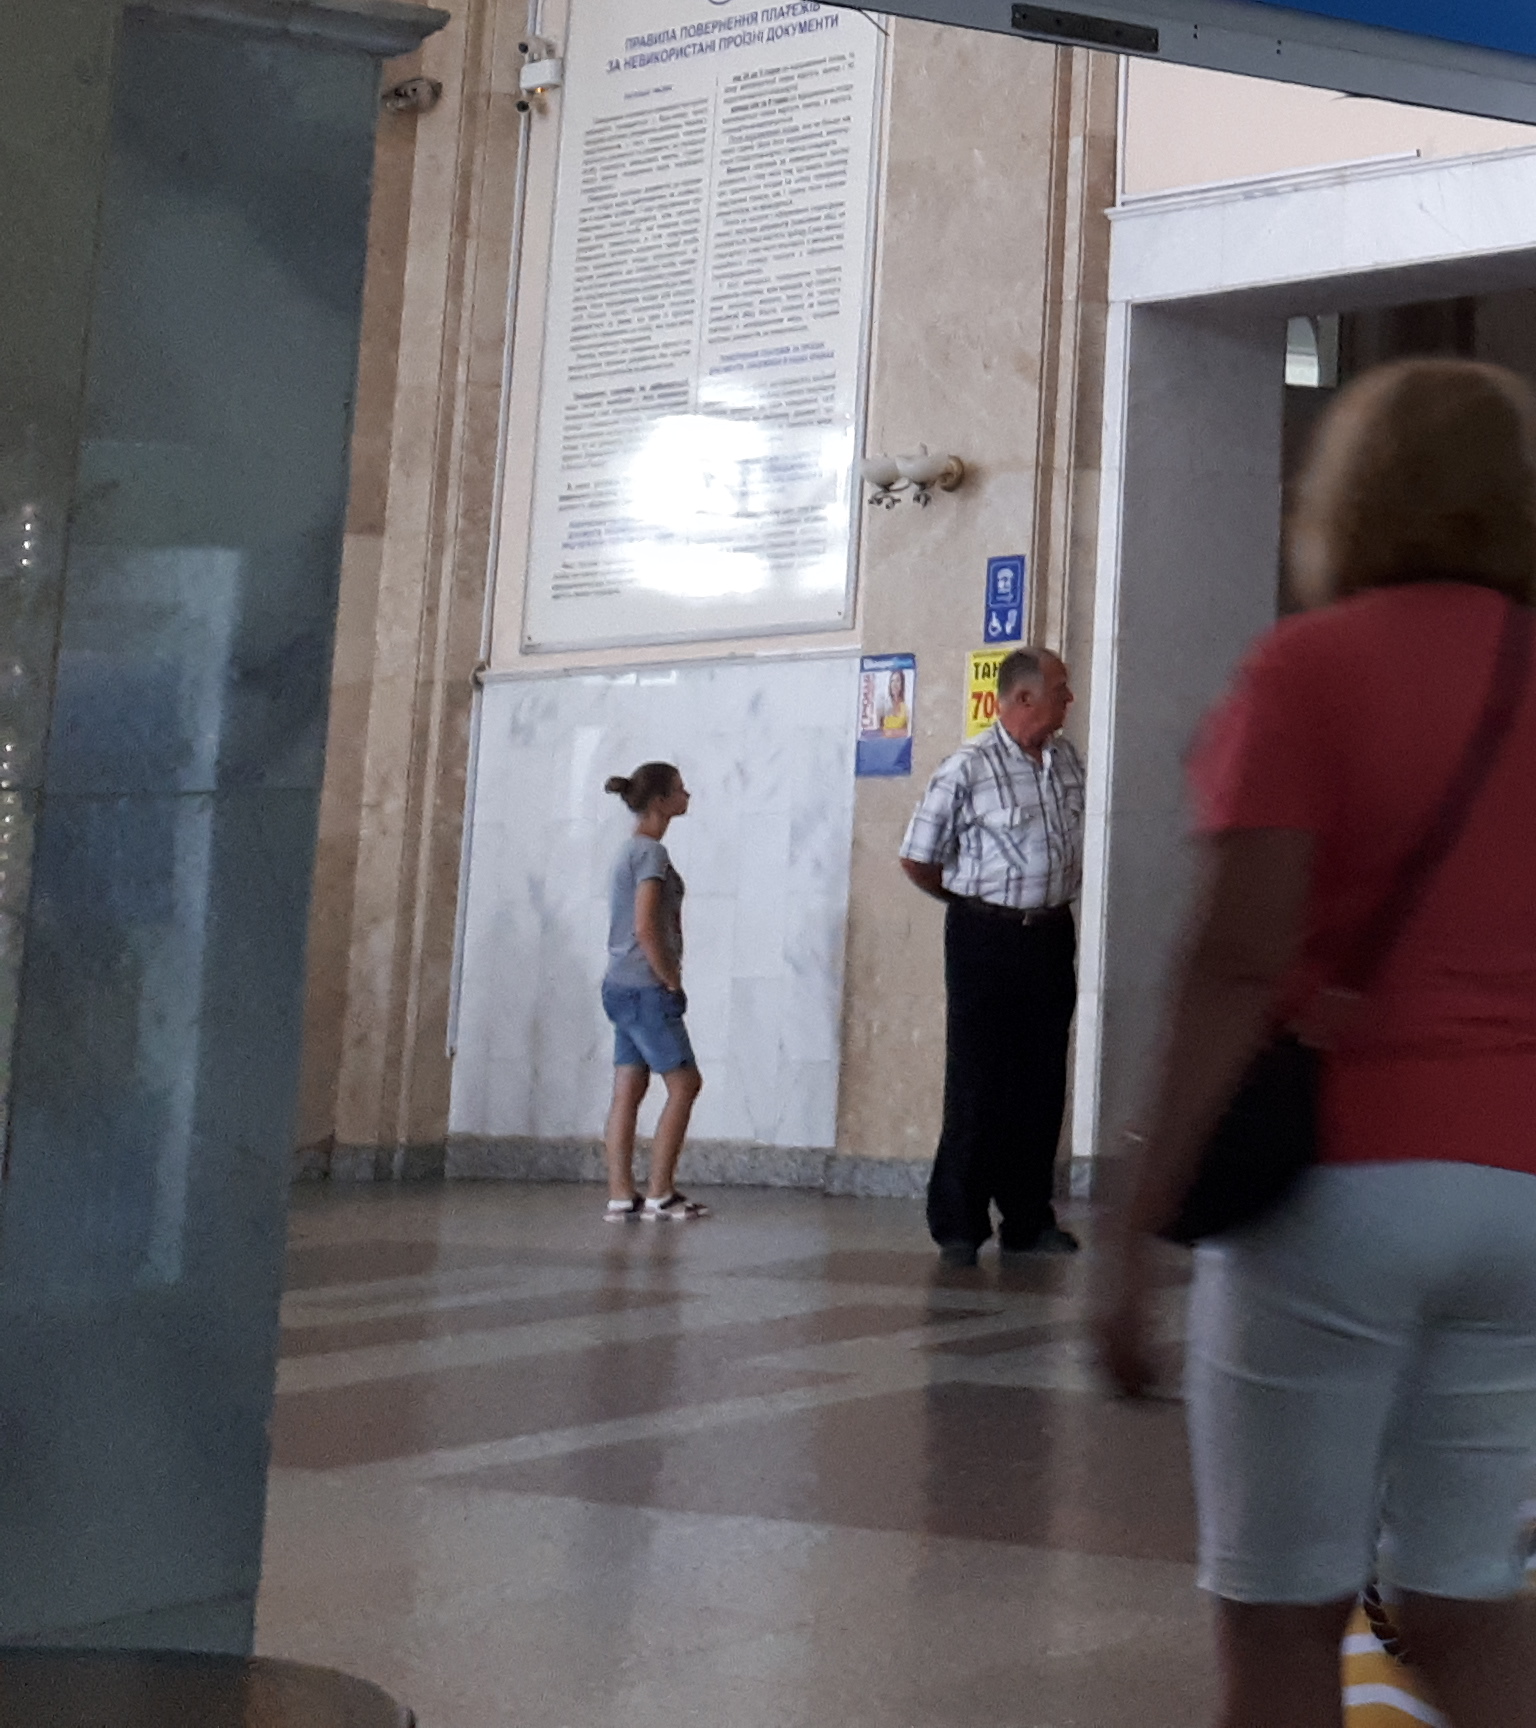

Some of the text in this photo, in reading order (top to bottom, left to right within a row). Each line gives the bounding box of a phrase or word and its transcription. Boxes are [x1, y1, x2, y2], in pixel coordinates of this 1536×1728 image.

[608, 13, 839, 73] ЗА НЕВИКОРИСТАНІ ПРОЇЗНІ ДОКУМЕНТИ
[625, 0, 821, 52] ПРАВИЛА ПОВЕРНЕННЯ ПЛАТЕЖІВ
